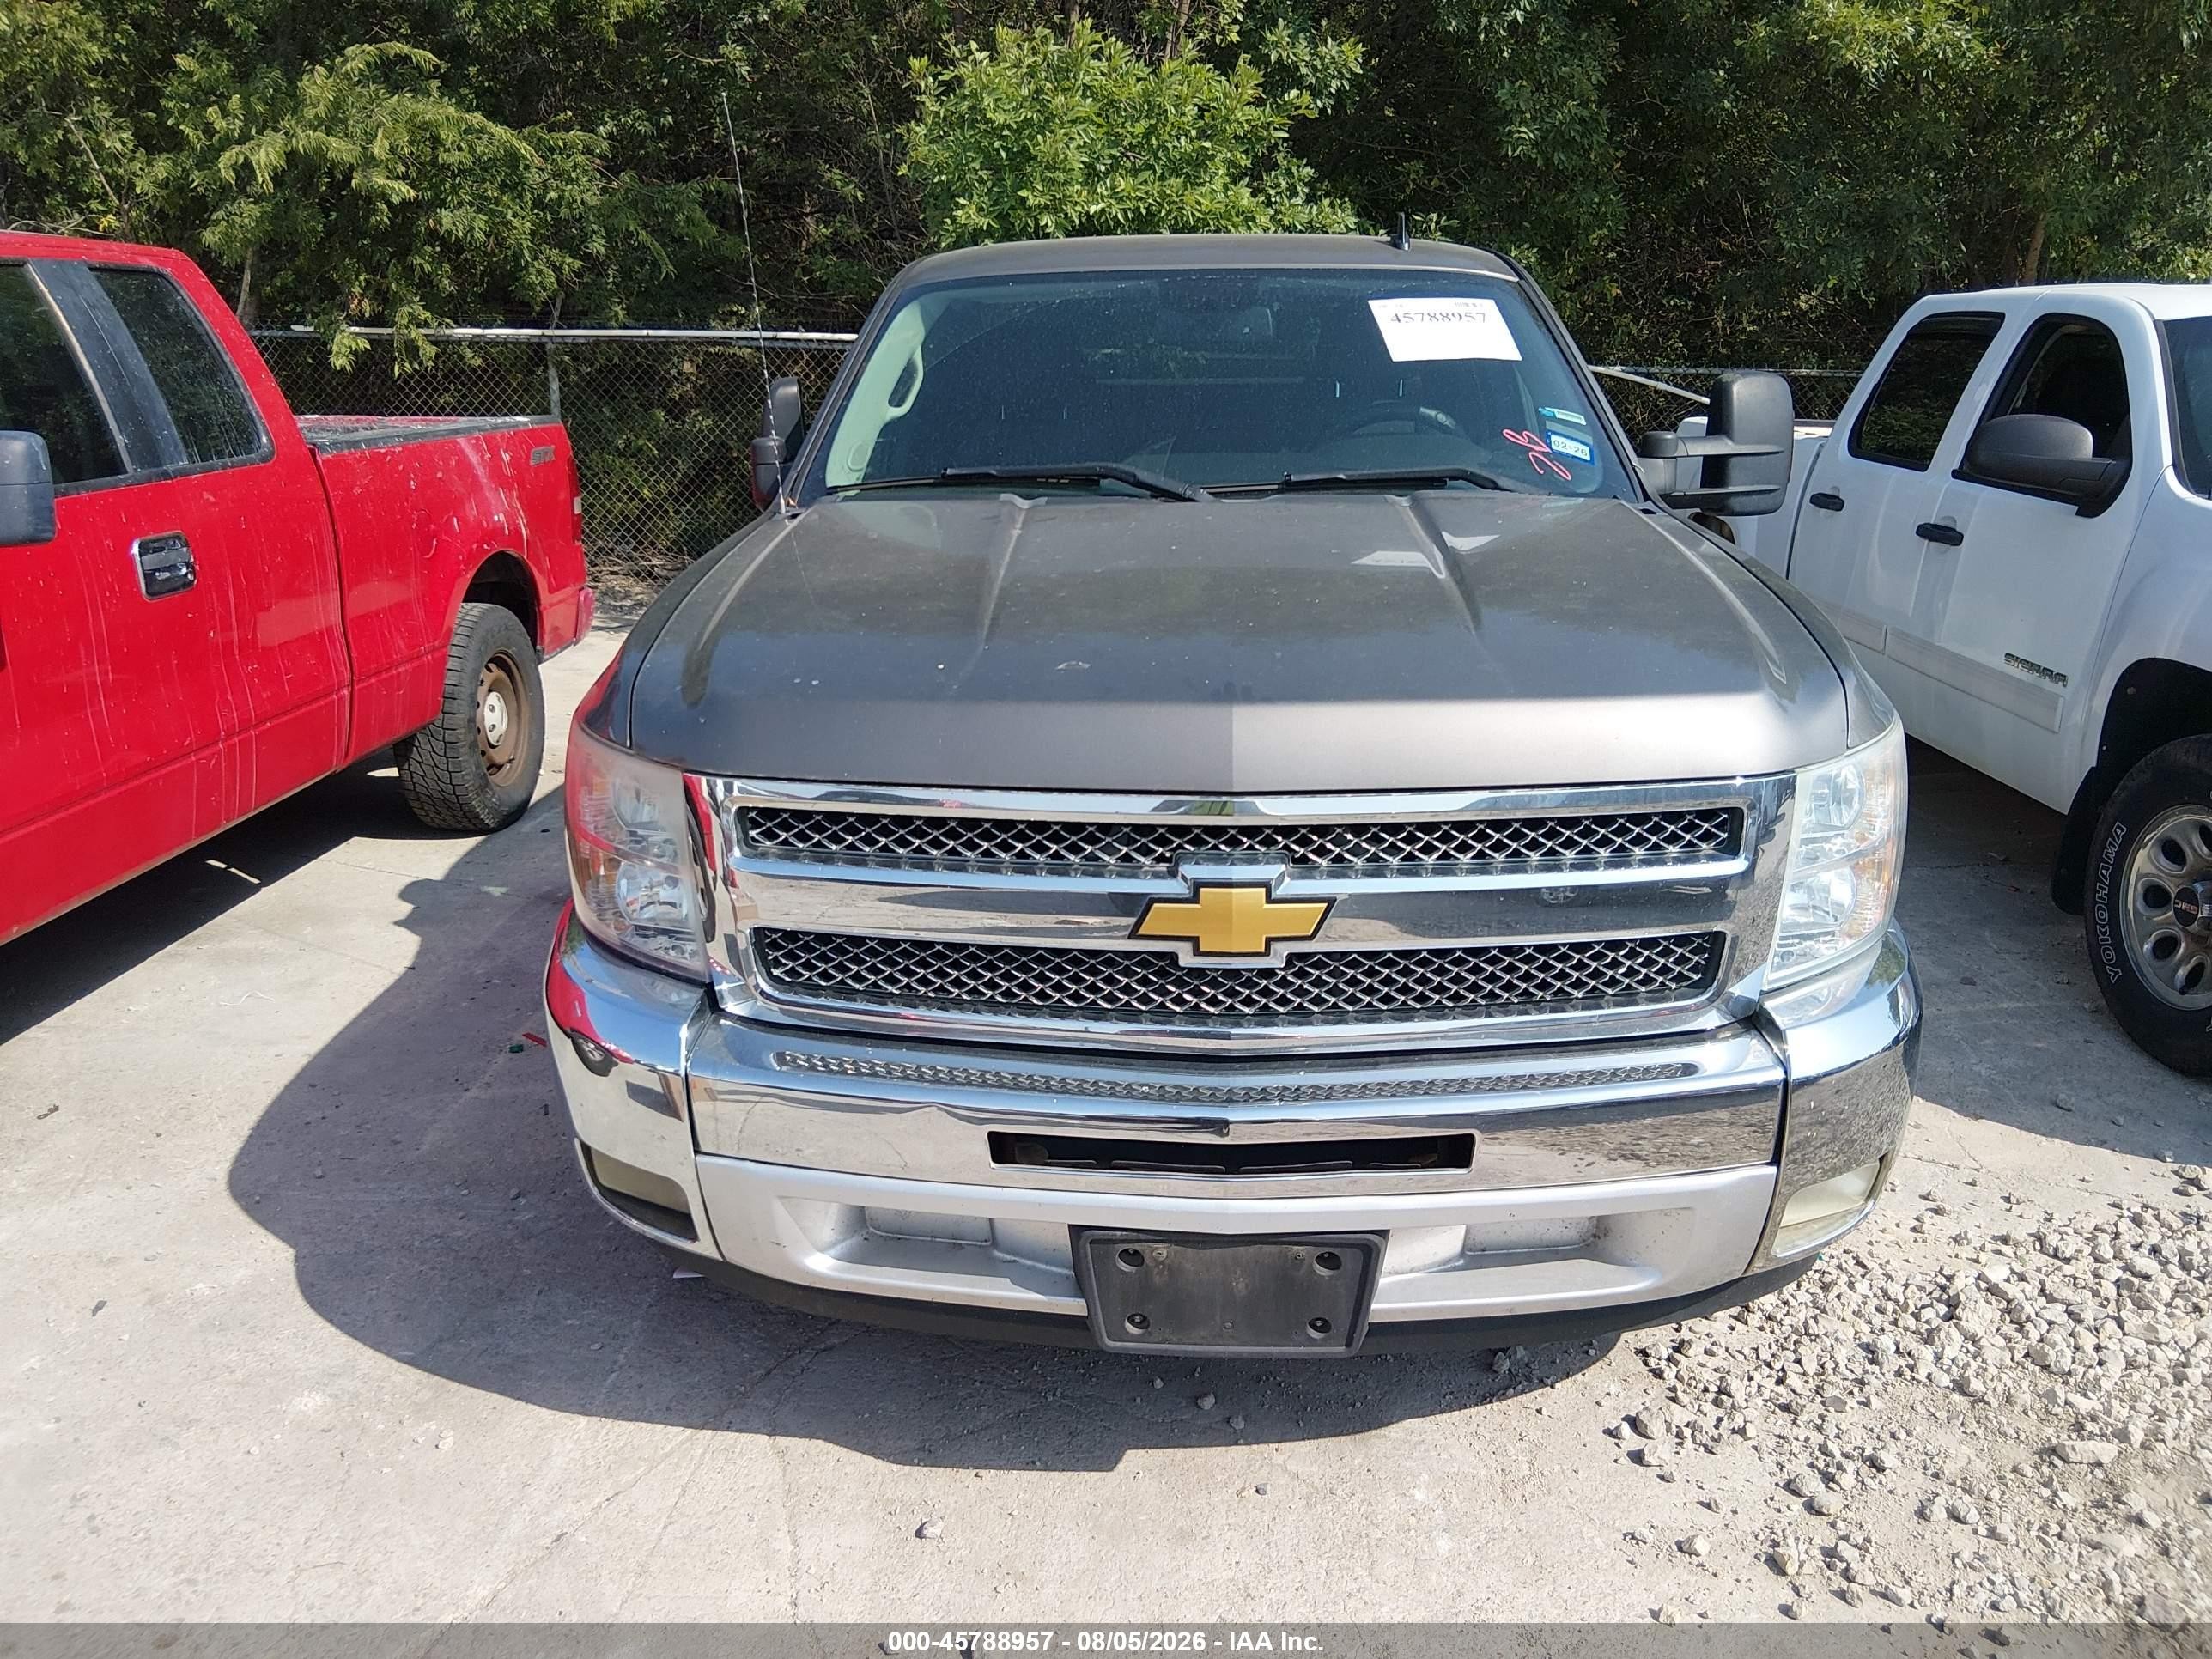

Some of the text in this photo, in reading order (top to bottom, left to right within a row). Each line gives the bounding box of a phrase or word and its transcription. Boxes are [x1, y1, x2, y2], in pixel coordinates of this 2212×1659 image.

[1390, 312, 1486, 324] 45788957
[2003, 653, 2069, 687] SIERRA
[2094, 821, 2127, 984] YOKOHAMA
